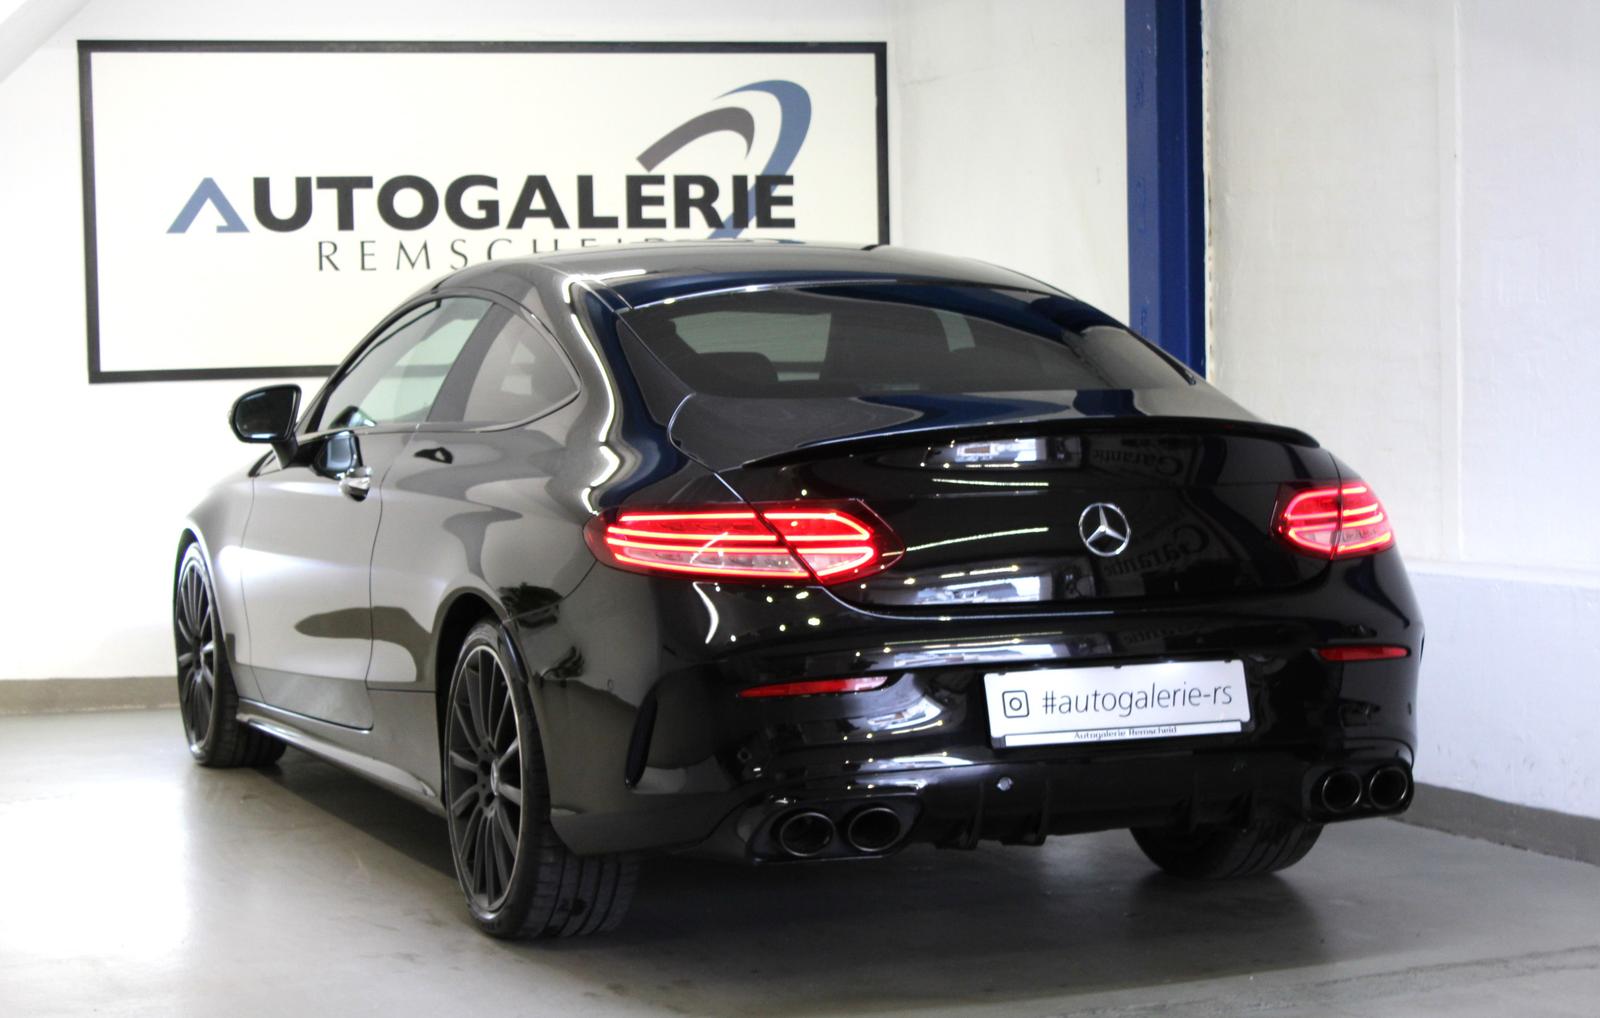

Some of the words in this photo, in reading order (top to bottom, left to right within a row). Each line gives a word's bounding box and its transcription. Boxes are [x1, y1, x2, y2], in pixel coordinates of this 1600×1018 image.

[166, 175, 795, 233] AUTOGALERIE
[318, 238, 665, 271] REMSC
[1042, 682, 1233, 718] #autogalerie-rs
